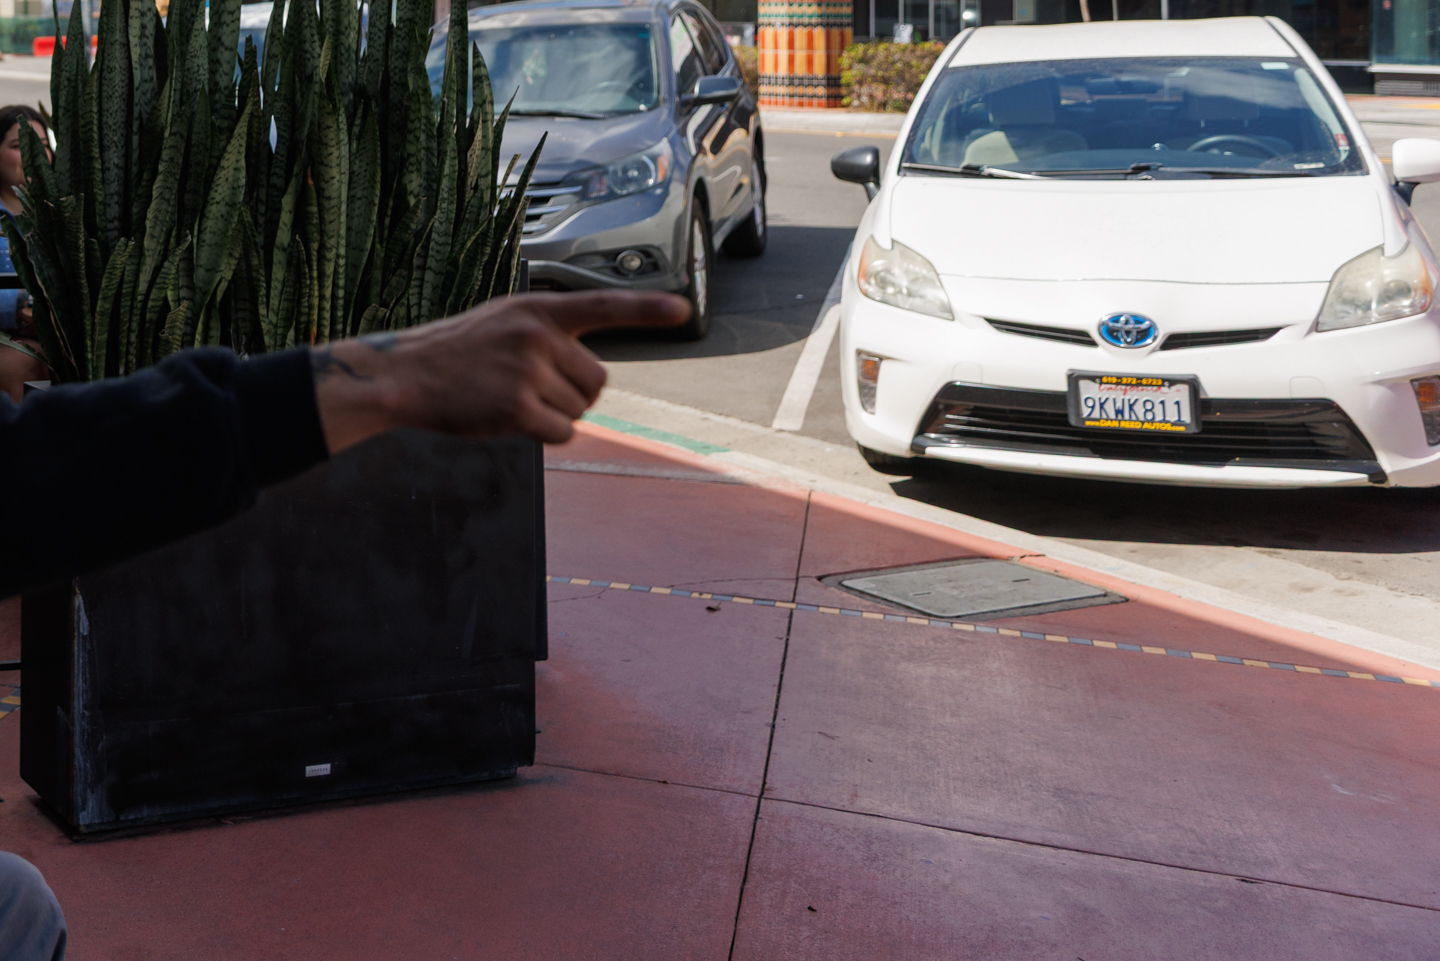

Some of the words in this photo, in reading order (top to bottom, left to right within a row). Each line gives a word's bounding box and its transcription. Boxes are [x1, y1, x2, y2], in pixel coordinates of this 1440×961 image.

[1098, 383, 1170, 396] California
[1083, 396, 1185, 422] 9KWK811
[1120, 420, 1142, 429] REED
